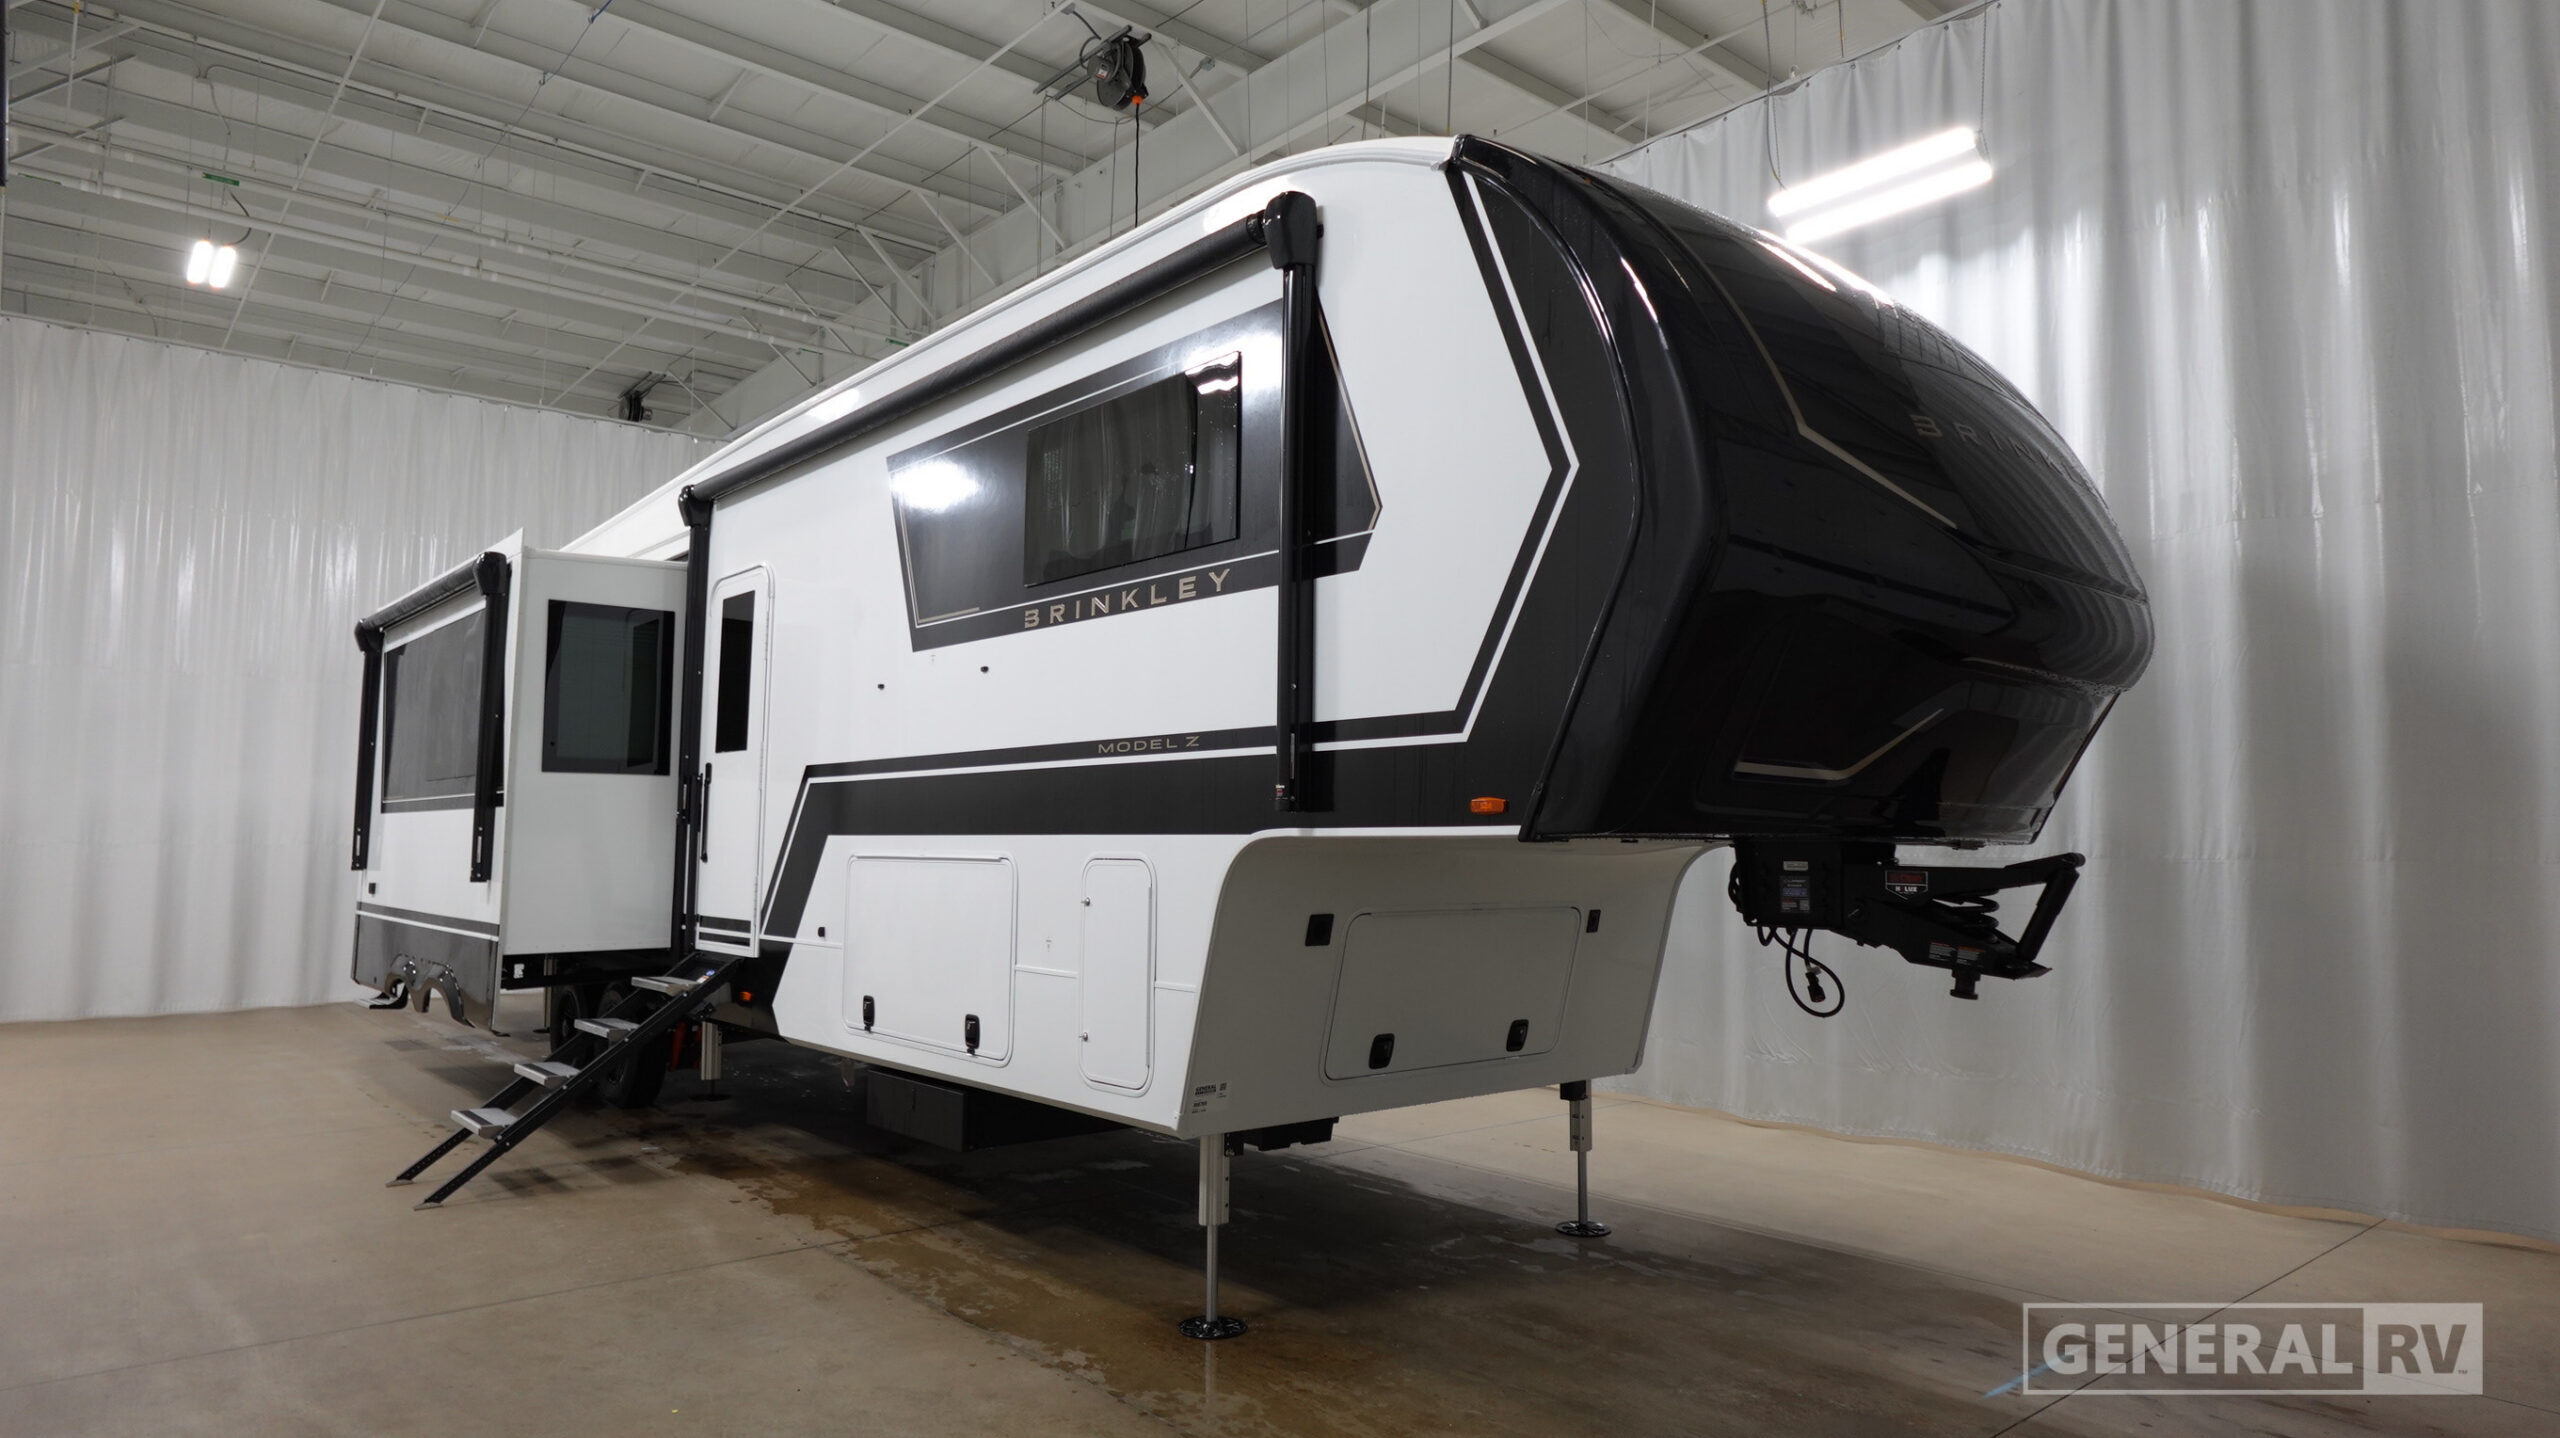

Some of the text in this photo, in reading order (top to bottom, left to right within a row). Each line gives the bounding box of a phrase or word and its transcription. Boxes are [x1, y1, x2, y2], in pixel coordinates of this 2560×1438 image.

[1024, 568, 1231, 629] BRINKLEY
[1097, 736, 1200, 754] MODEL Z
